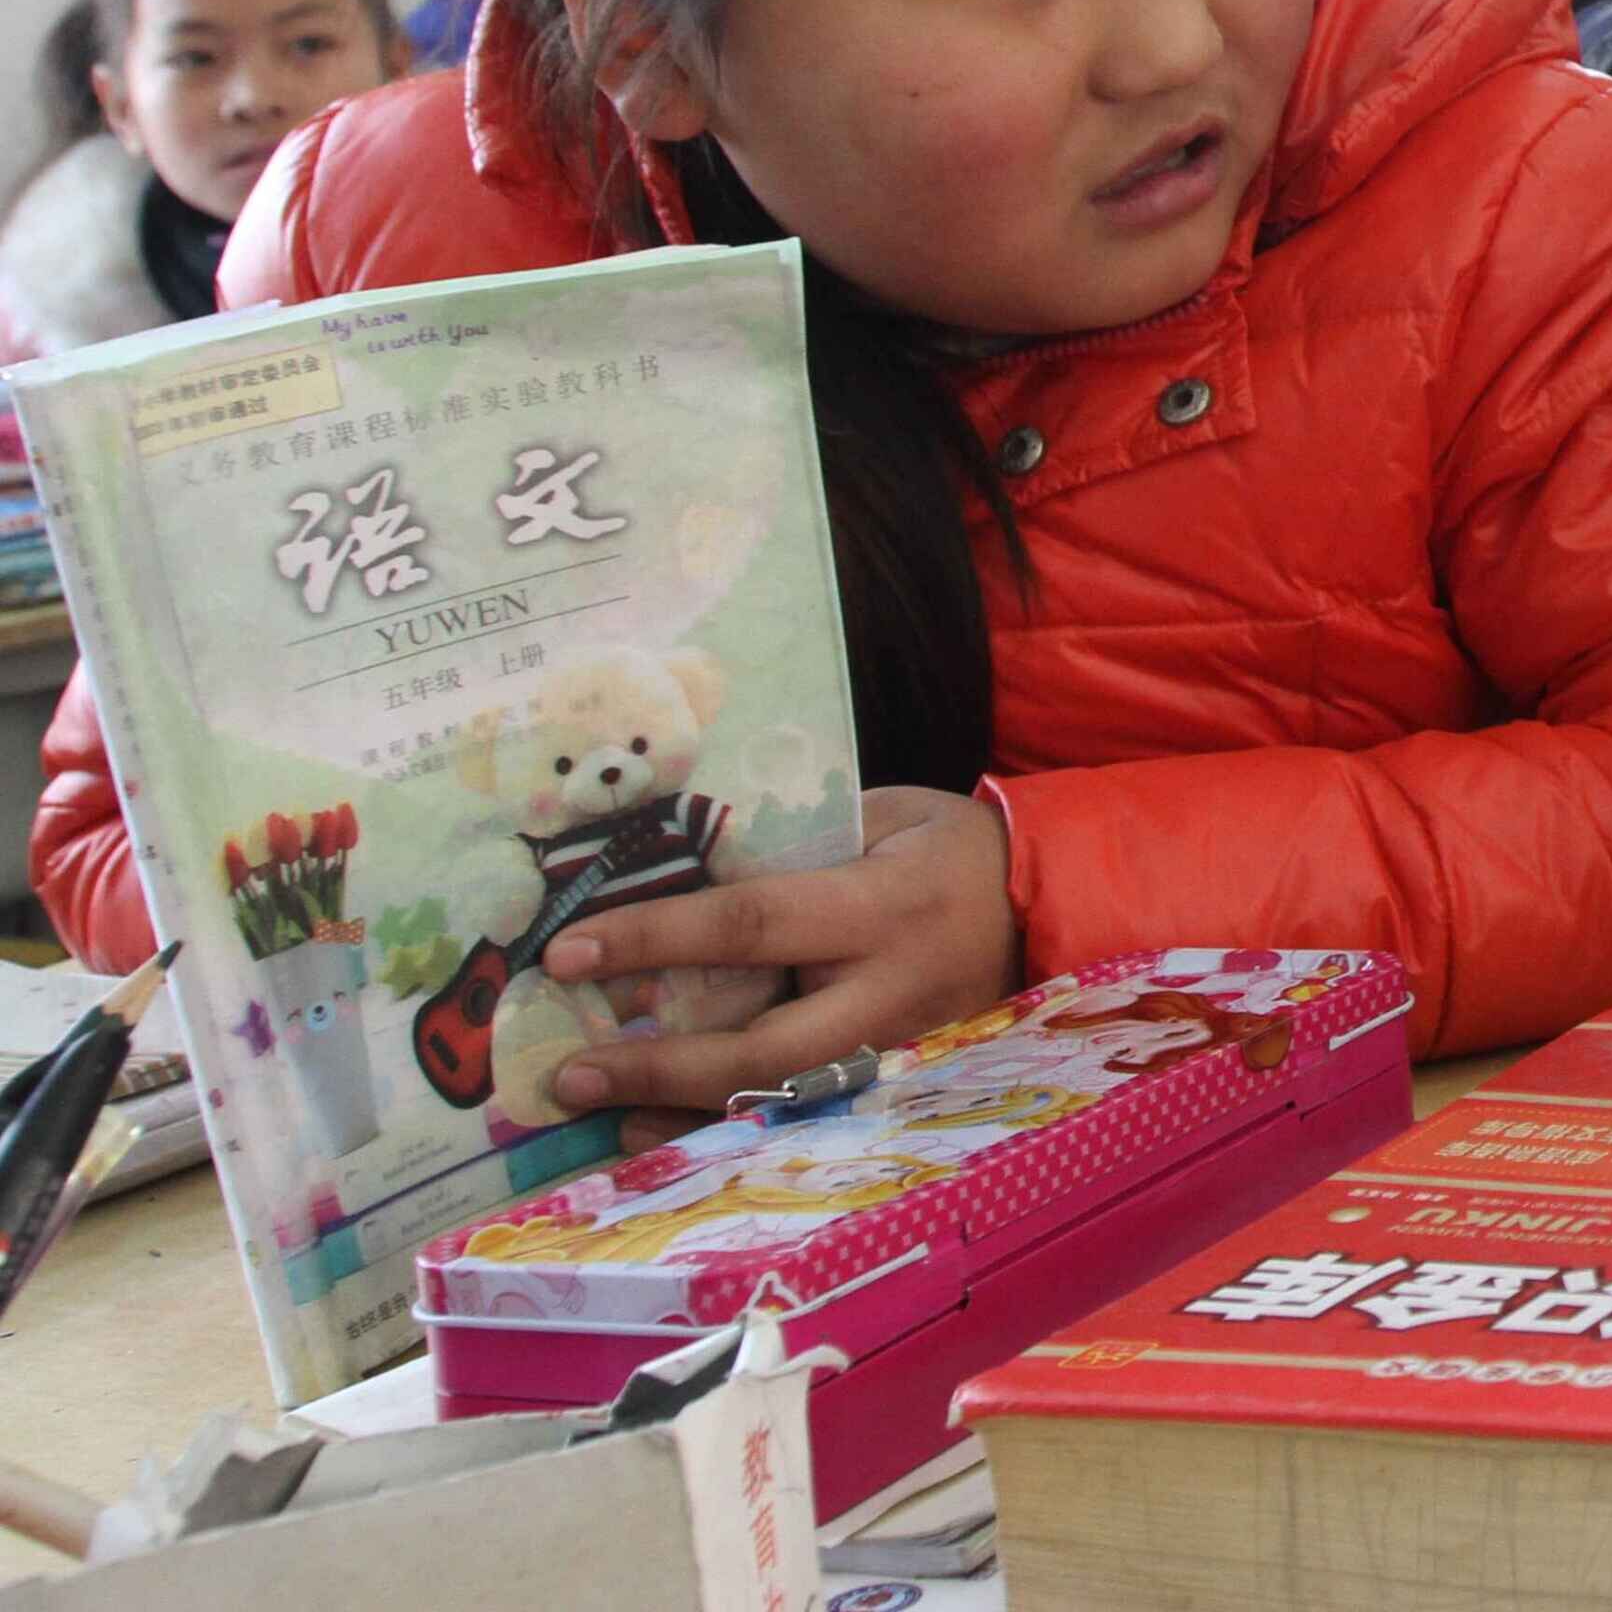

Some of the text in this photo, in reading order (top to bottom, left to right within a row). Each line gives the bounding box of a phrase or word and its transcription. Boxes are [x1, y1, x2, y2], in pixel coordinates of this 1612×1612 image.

[374, 589, 531, 654] YUWEN
[382, 642, 547, 711] 五年级 上册
[1407, 1207, 1612, 1233] JINKU
